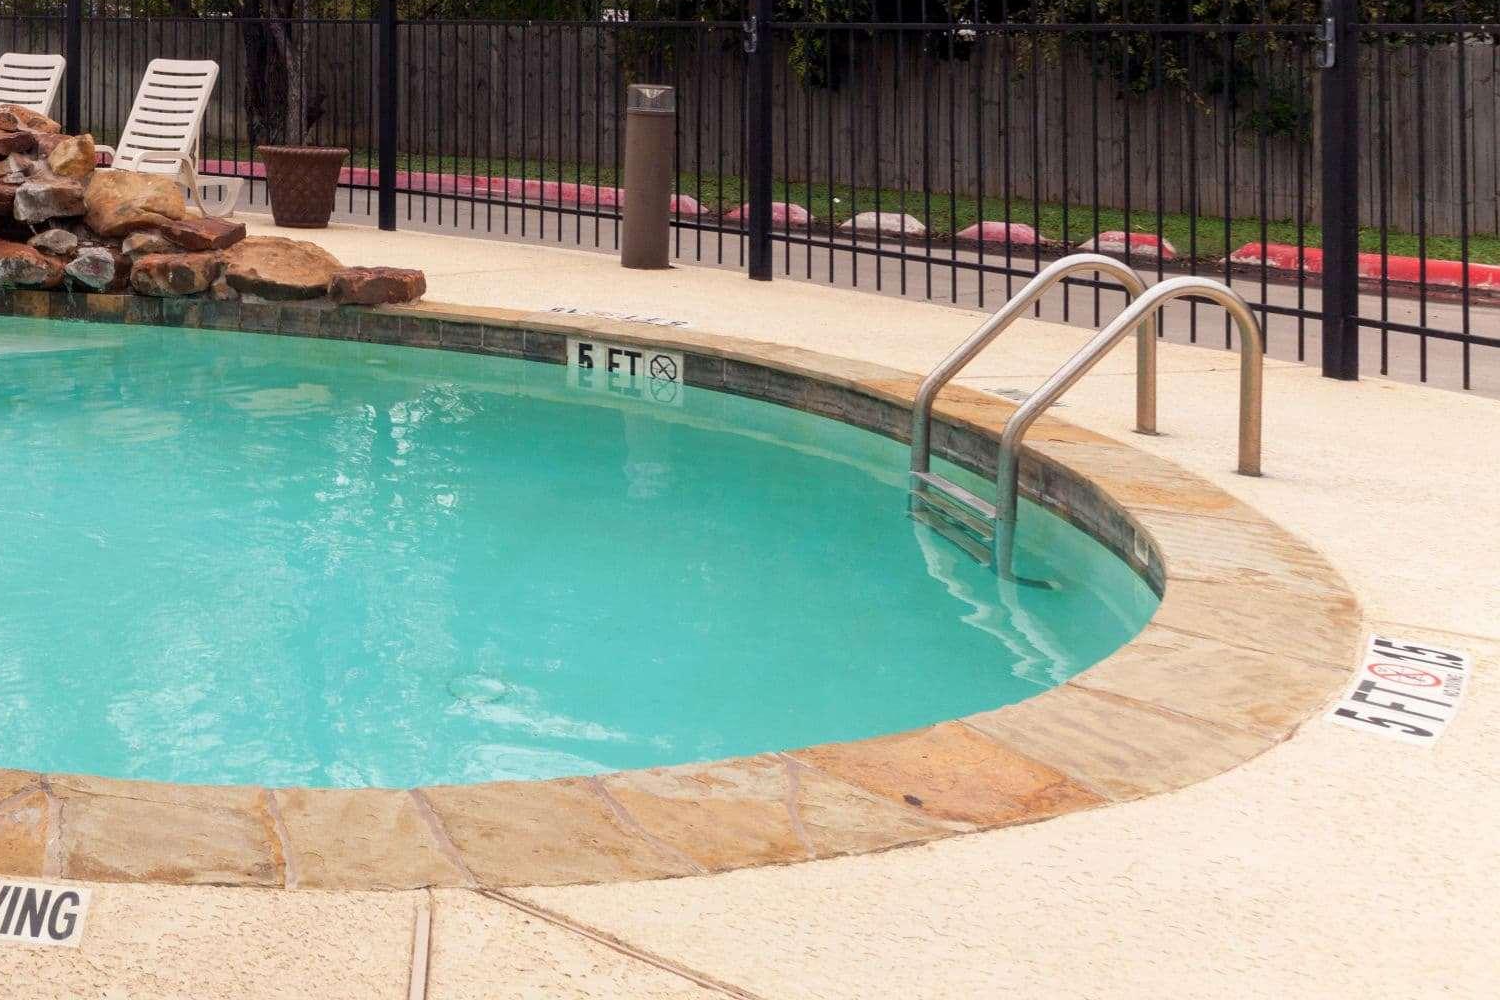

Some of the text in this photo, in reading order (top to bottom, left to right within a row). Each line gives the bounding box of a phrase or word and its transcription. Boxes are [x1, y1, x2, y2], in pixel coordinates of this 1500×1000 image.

[578, 342, 642, 376] 5 FT
[1334, 679, 1453, 737] 5 FT
